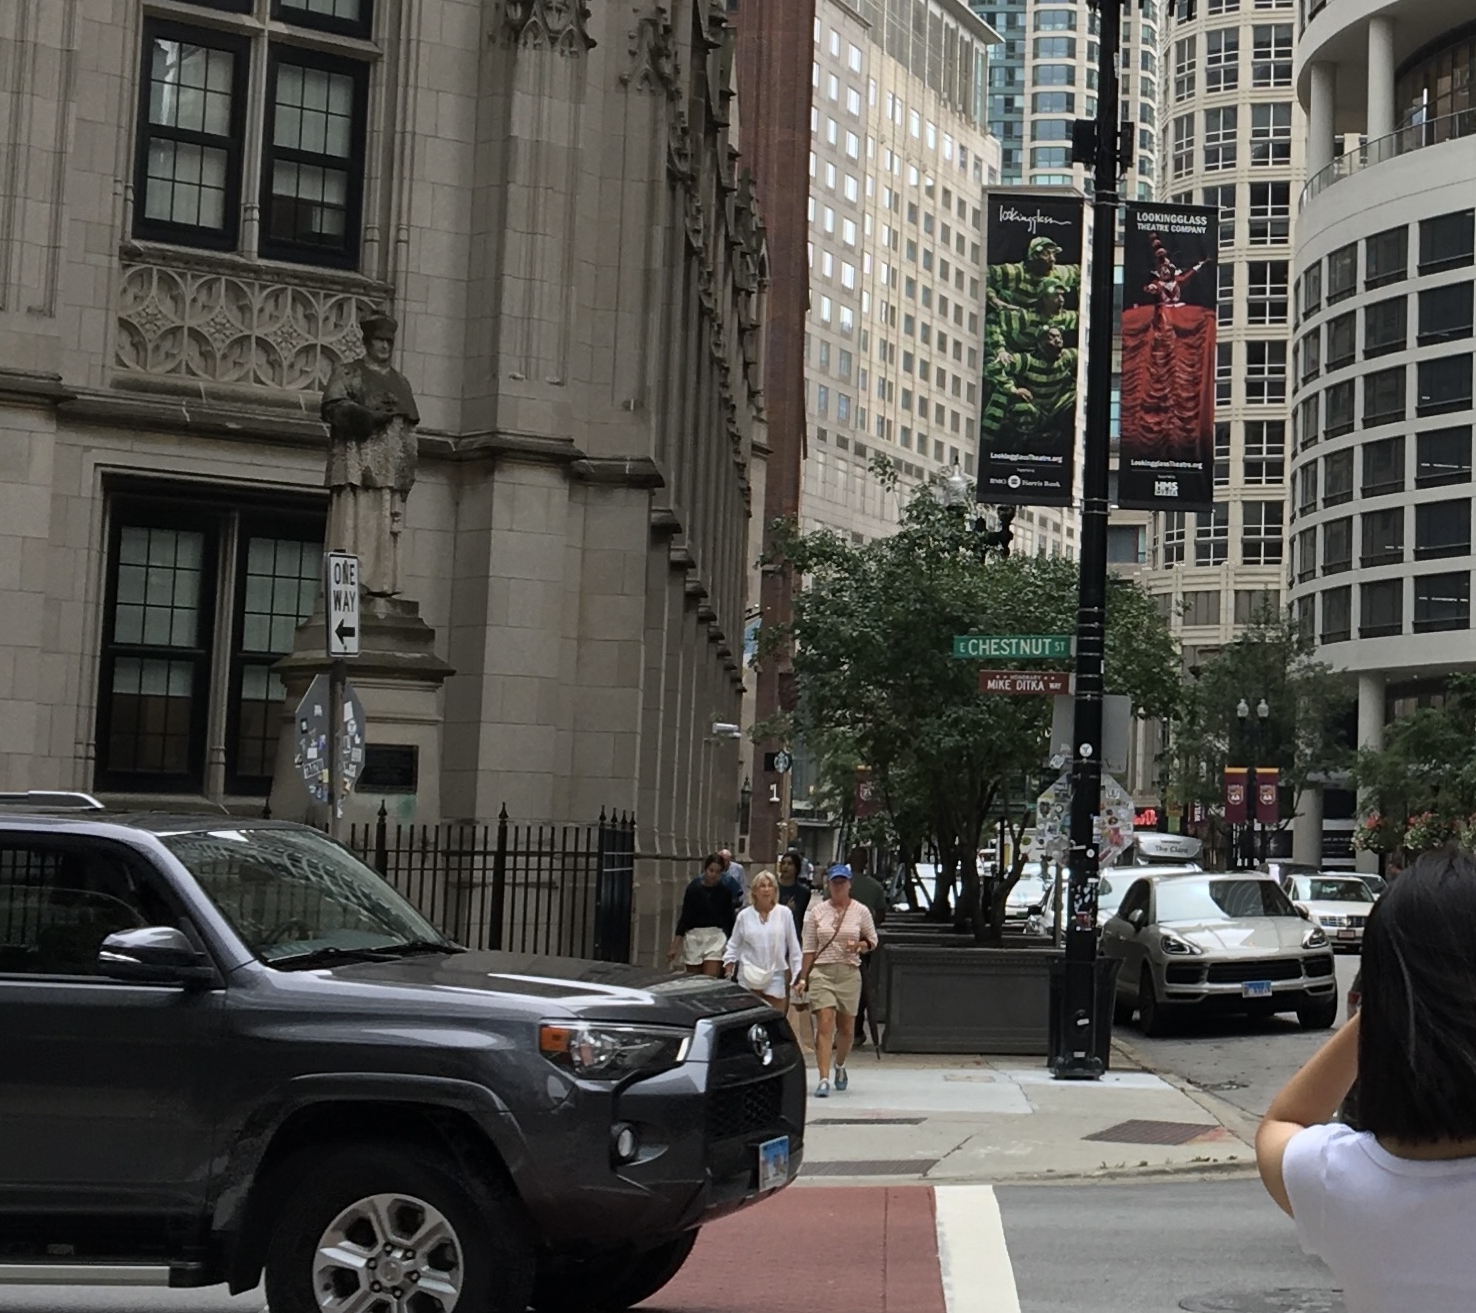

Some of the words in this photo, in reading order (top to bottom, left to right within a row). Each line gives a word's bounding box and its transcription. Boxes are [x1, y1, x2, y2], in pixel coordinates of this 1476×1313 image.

[1136, 211, 1208, 226] LOOKINGGLASS
[1136, 222, 1170, 233] THEATRE
[1170, 224, 1207, 234] COMPANY
[1154, 480, 1178, 491] HMS
[333, 561, 356, 586] ONE
[333, 589, 356, 613] WAY
[960, 642, 966, 653] E
[968, 638, 1052, 656] CHESTNUT
[1054, 641, 1065, 652] ST
[986, 679, 1011, 691] MIKE
[1015, 680, 1045, 691] DITKA
[1048, 682, 1062, 690] WAY
